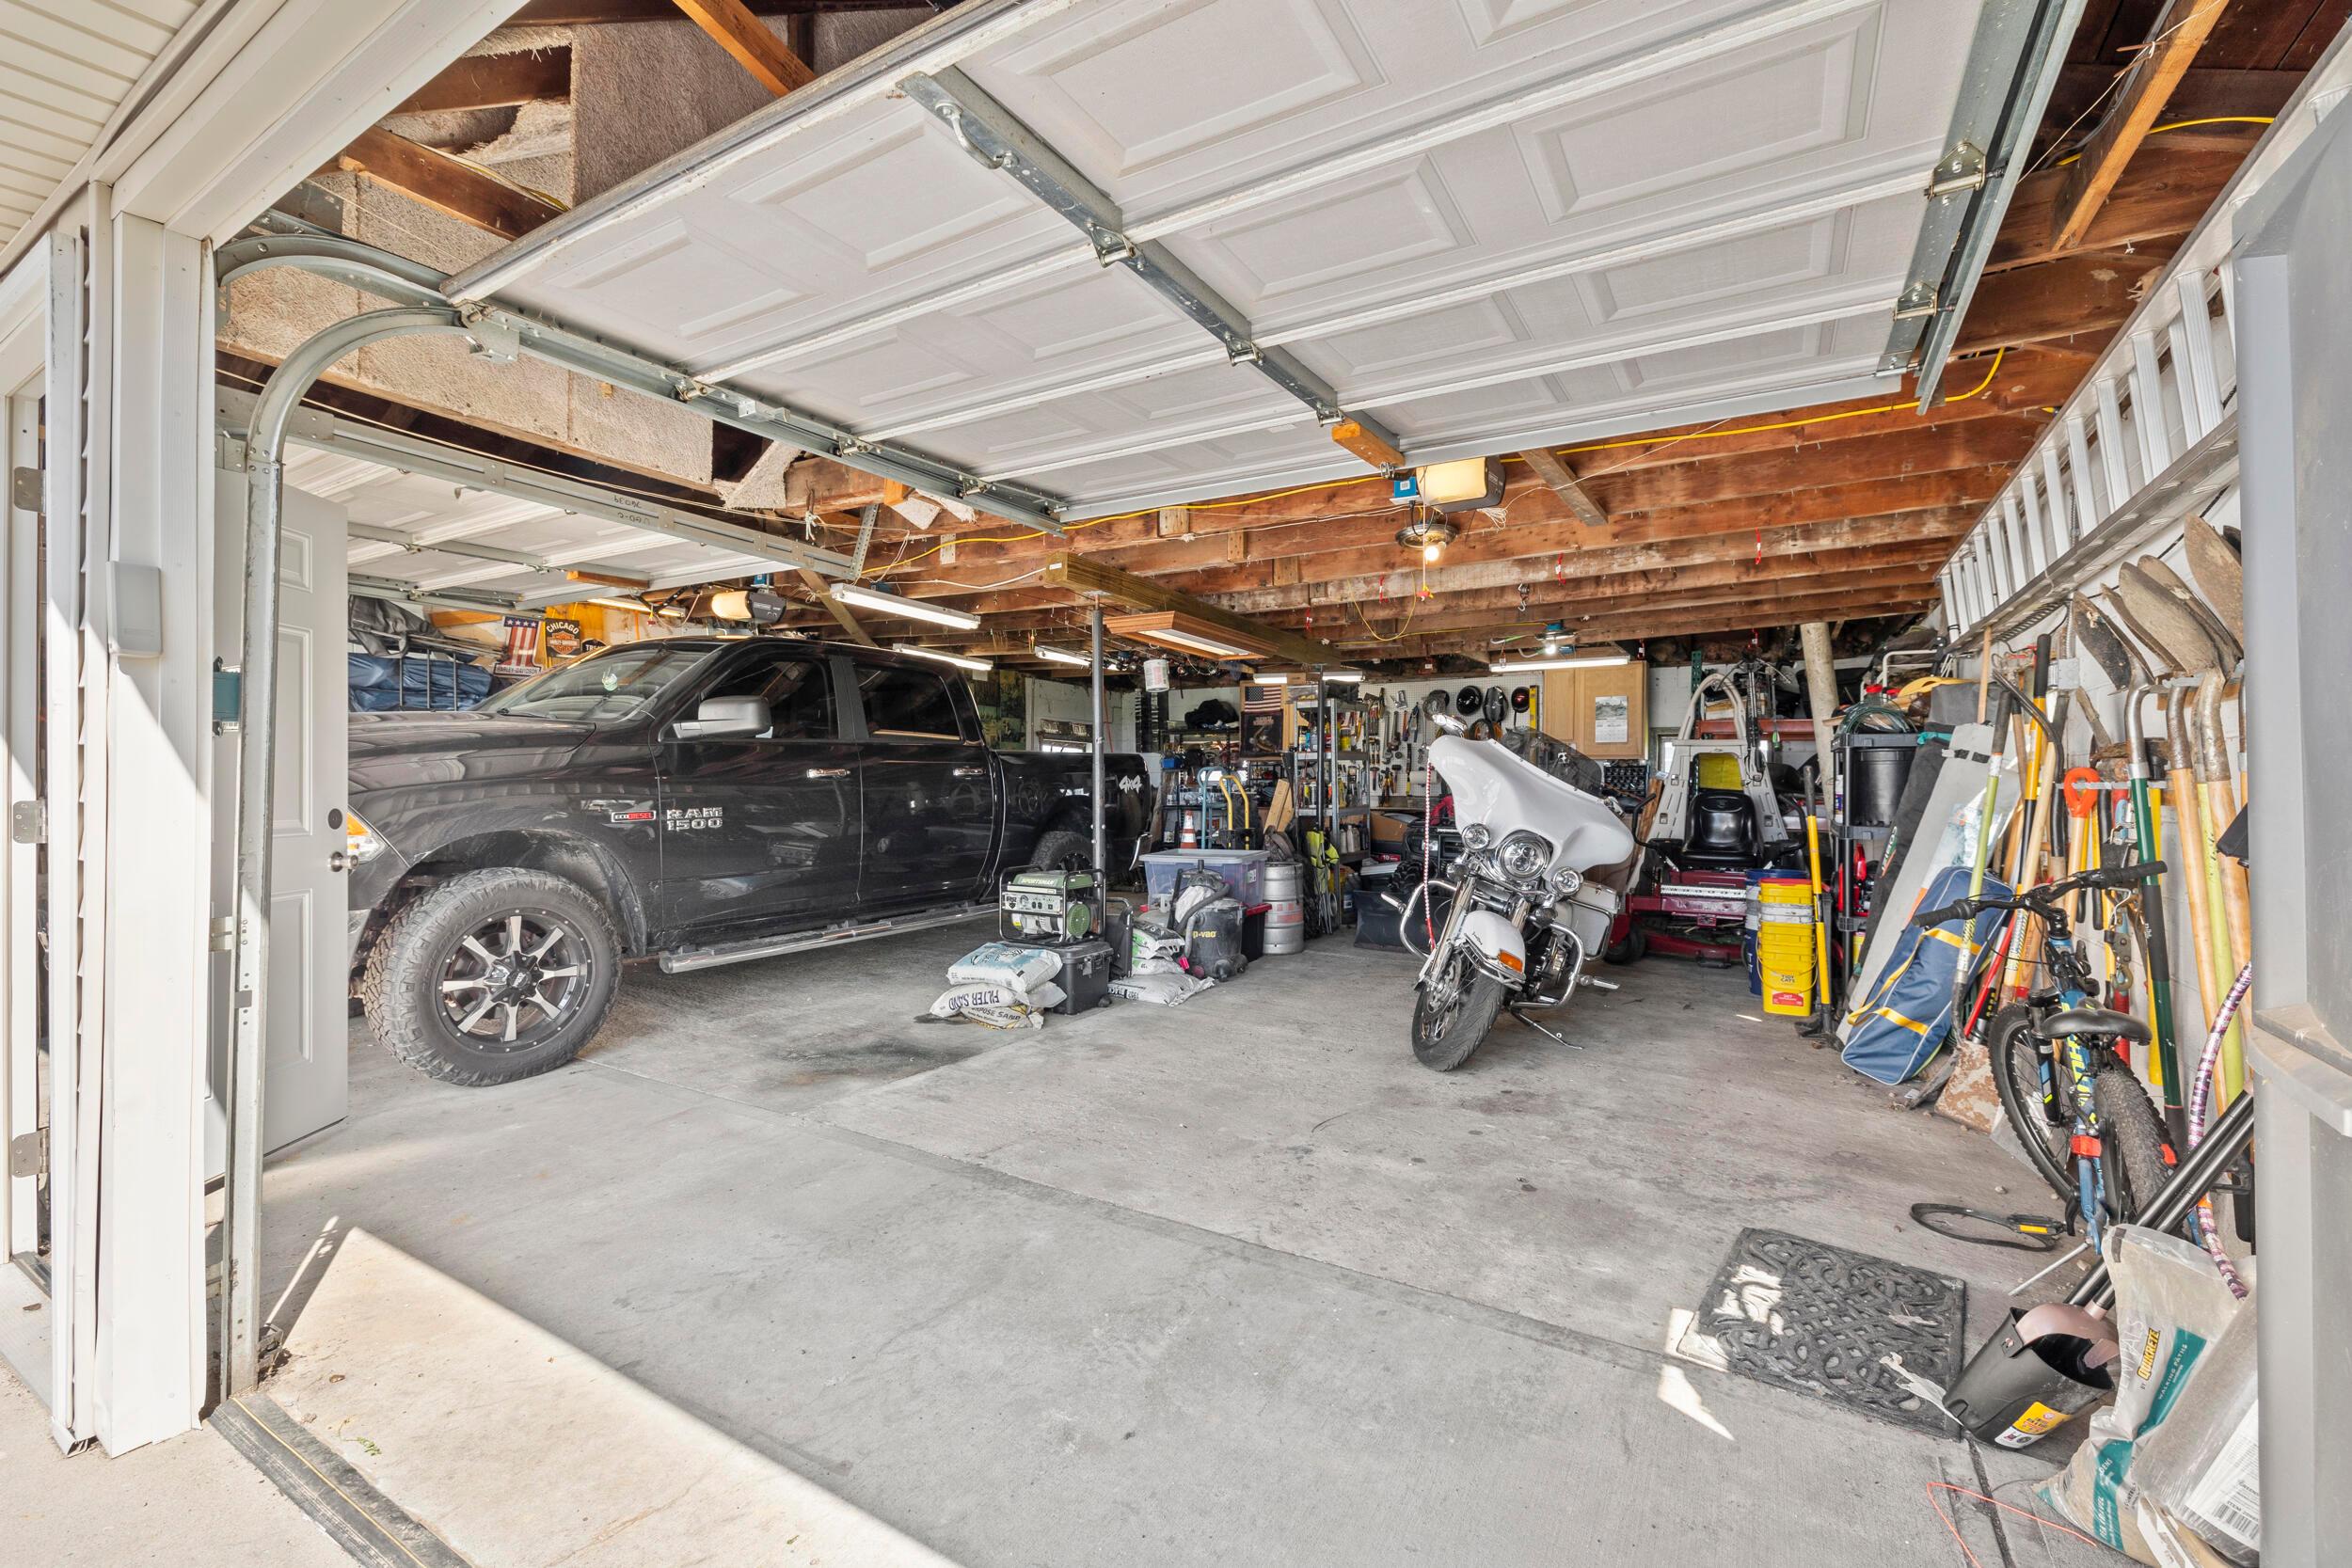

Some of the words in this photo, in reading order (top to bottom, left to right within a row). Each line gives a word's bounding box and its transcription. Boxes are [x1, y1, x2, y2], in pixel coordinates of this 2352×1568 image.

[546, 621, 580, 635] CHICAGO
[1119, 775, 1142, 794] 4x4
[666, 807, 723, 820] RAM
[666, 818, 723, 832] 1500
[948, 994, 970, 1011] SAND
[972, 990, 1000, 1006] FILTER
[998, 1011, 1022, 1021] SAND
[2137, 1327, 2161, 1381] QUIKRETE
[2159, 1369, 2176, 1400] WALKING
[2173, 1343, 2188, 1367] PATHS
